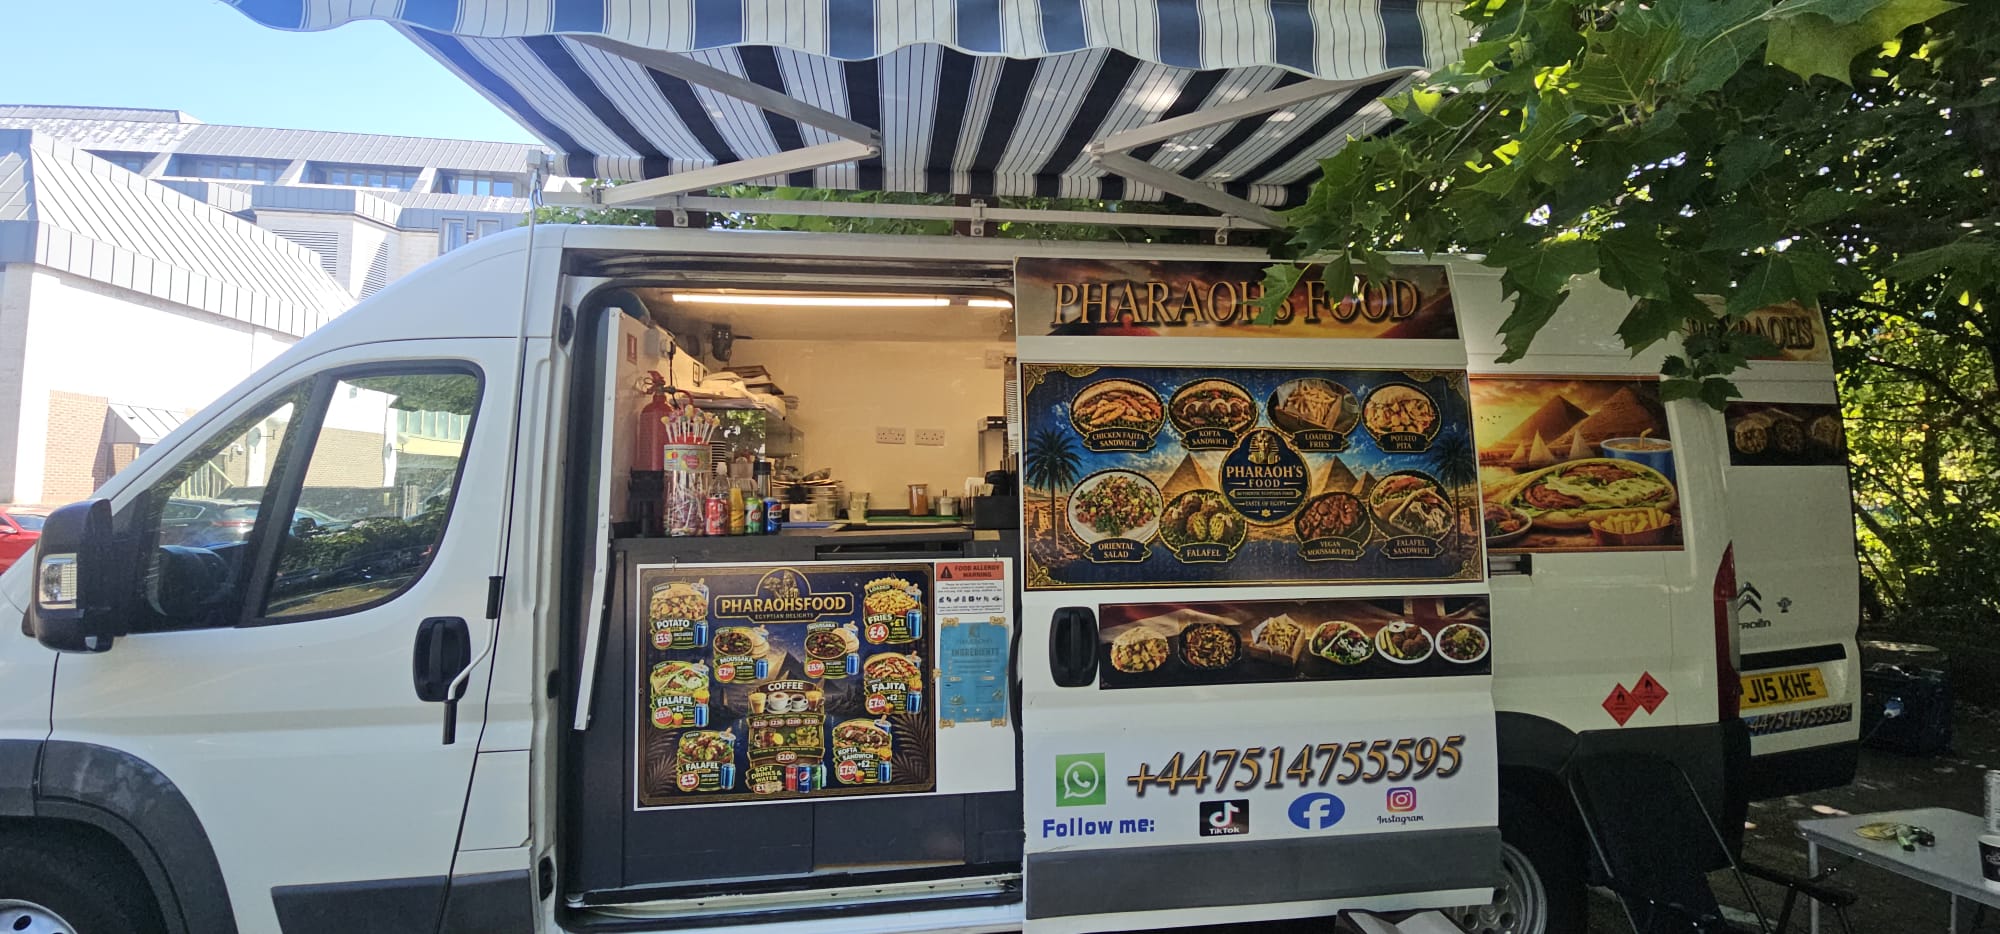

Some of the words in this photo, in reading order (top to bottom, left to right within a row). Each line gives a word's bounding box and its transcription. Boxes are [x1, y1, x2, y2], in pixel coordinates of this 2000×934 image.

[1305, 279, 1418, 322] FOOD
[1092, 431, 1121, 441] CHICKEN
[1122, 431, 1144, 441] FAJITA
[1200, 430, 1221, 438] KOFTA
[1305, 433, 1334, 441] LOADED
[1390, 434, 1416, 442] POTATO
[1192, 438, 1228, 446] SANDWICH
[1309, 440, 1330, 448] FRIES
[1396, 442, 1412, 450] PITA
[1226, 465, 1304, 478] PHARAOH'S
[1249, 479, 1281, 488] FOOD
[1397, 539, 1426, 547] FALAFEL
[1104, 551, 1129, 559] SALAD
[1187, 549, 1221, 557] FALAFEL
[1393, 547, 1430, 555] SANDWICH
[721, 597, 846, 613] PHARAOHSFOOD
[868, 614, 893, 625] FRIES
[656, 620, 690, 630] POTATO
[869, 627, 885, 639] £4
[719, 656, 754, 664] MOUSSAKA
[768, 682, 804, 691] COFFEE
[872, 682, 906, 692] FAJITA
[1740, 677, 1779, 704] J15
[1779, 672, 1817, 699] KHE
[657, 696, 693, 706] FALAFEL
[838, 747, 858, 755] KOFTA
[686, 762, 719, 771] FALAFEL
[1126, 735, 1465, 796] +447514755595
[681, 774, 696, 786] £5
[752, 771, 776, 780] DRINKS
[756, 775, 777, 783] WATER
[1376, 812, 1425, 826] Instagram
[1042, 817, 1113, 839] Follow
[1118, 817, 1156, 834] me:
[1209, 826, 1240, 835] TikTok
